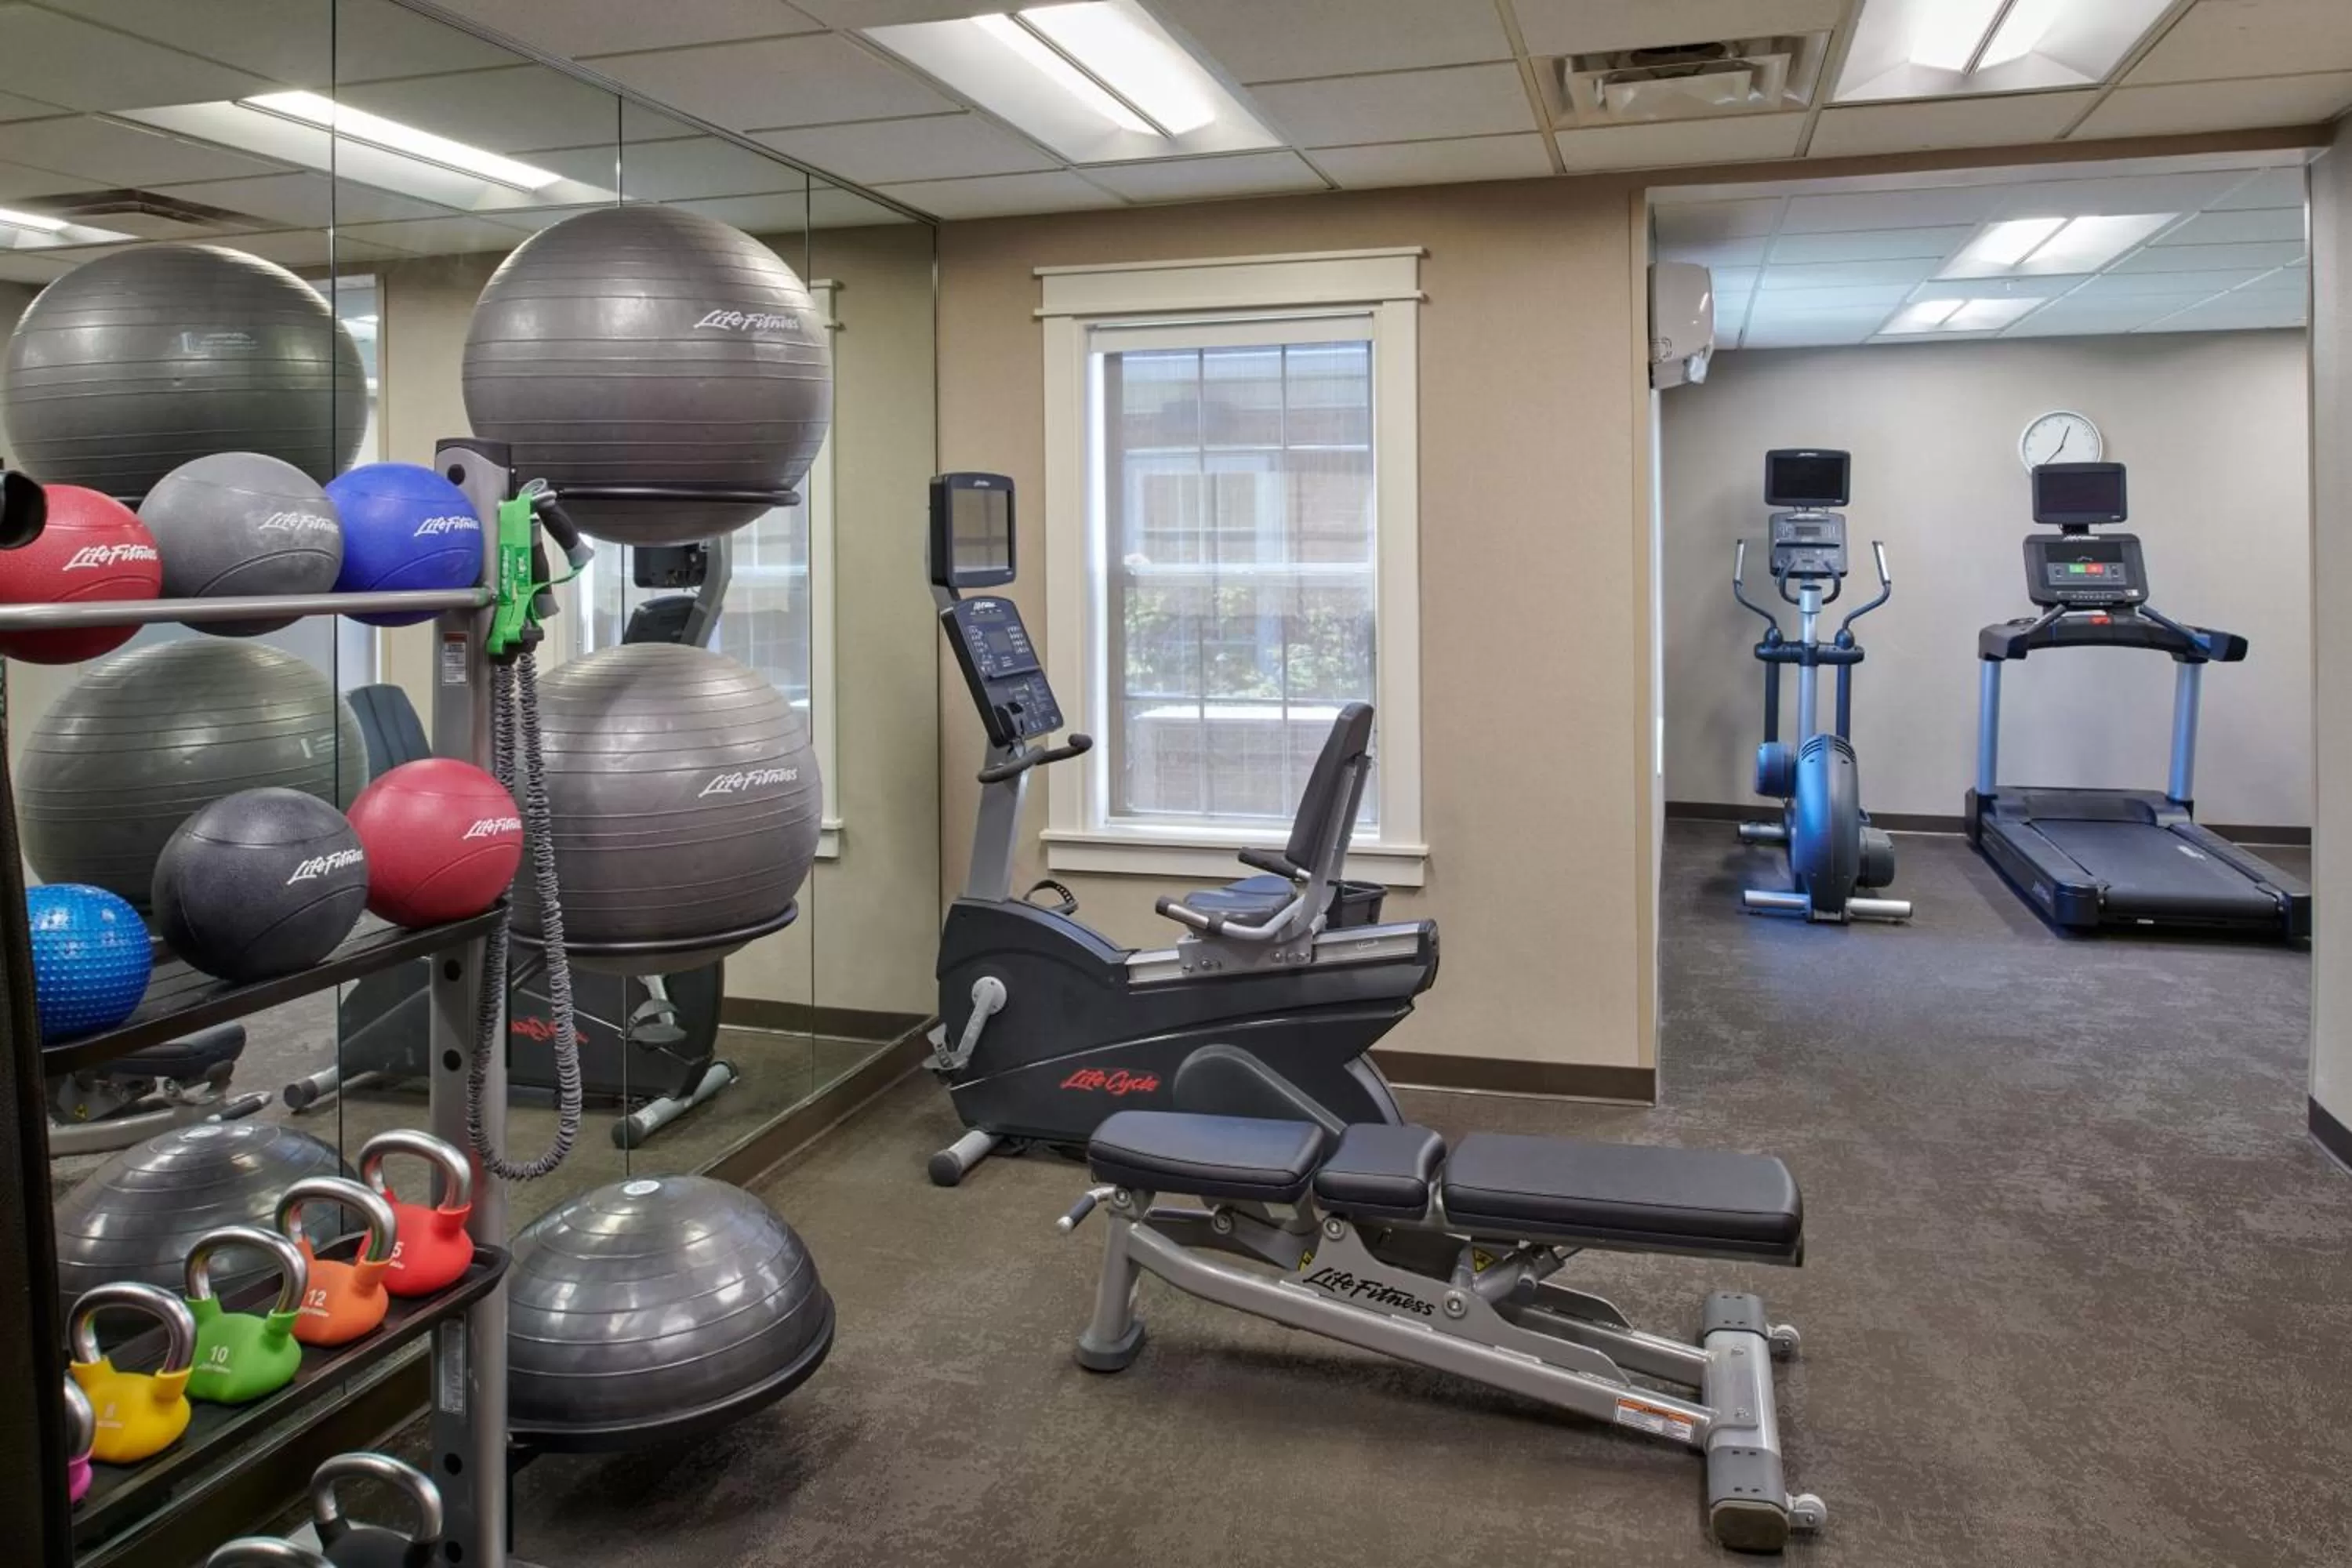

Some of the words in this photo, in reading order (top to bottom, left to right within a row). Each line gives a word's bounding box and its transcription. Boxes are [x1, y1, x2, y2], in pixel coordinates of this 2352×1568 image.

[693, 309, 743, 331] Life
[259, 511, 298, 531] Life
[414, 517, 446, 536] Life
[63, 544, 111, 571] Life
[698, 771, 743, 798] Life
[461, 818, 495, 840] Life
[286, 856, 325, 884] Life
[1060, 1069, 1106, 1091] Life
[309, 1289, 327, 1307] 12
[1303, 1267, 1356, 1292] Life
[1349, 1279, 1436, 1316] Fitness
[210, 1345, 229, 1363] 10
